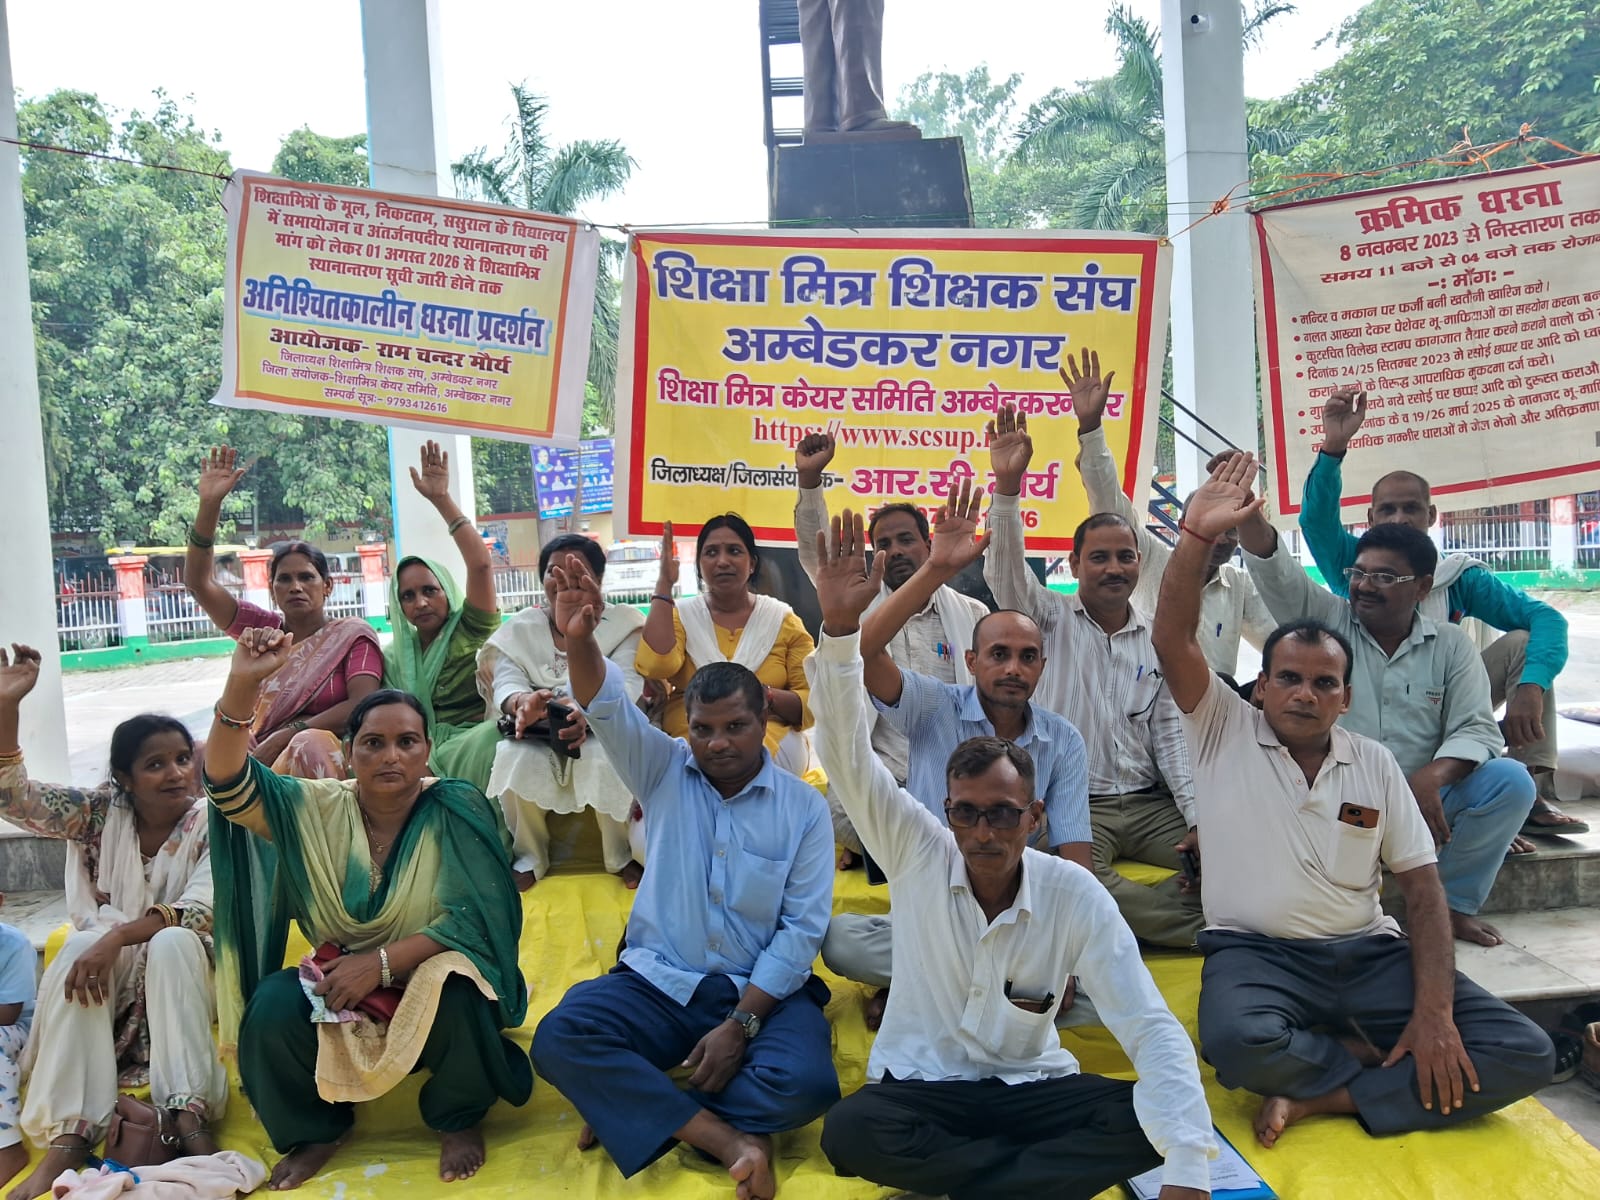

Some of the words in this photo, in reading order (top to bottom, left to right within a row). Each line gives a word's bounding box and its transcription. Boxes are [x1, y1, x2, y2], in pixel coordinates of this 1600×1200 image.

[254, 187, 322, 210] शिक्षामित्रों
[323, 195, 338, 211] के
[341, 200, 370, 219] मूल,
[375, 202, 437, 228] निकटतम,
[443, 214, 492, 234] ससुराल
[495, 219, 510, 234] के
[512, 221, 568, 242] विद्यालय
[1355, 196, 1464, 234] क्रमिक
[1478, 181, 1563, 214] धरना
[267, 208, 282, 224] में
[283, 214, 350, 234] समायोजन
[353, 222, 364, 236] व
[367, 222, 450, 247] अंतर्जनपदीय
[529, 244, 549, 261] की
[1340, 246, 1351, 261] 8
[1356, 234, 1418, 258] नवम्बर
[1423, 230, 1458, 248] 2023
[1463, 222, 1480, 244] से
[1485, 214, 1564, 240] निस्तारण
[306, 235, 327, 251] को
[328, 237, 363, 256] लेकर
[366, 244, 381, 259] 01
[384, 247, 426, 264] अगस्त
[430, 252, 460, 269] 2026
[464, 255, 477, 272] से
[479, 257, 541, 281] शिक्षामित्र
[386, 264, 414, 286] सूची
[416, 272, 448, 288] जारी
[450, 275, 476, 292] होने
[478, 280, 504, 295] तक
[654, 250, 770, 302] शिक्षा
[781, 255, 876, 307] मित्र
[889, 257, 1043, 311] शिक्षक
[1053, 262, 1136, 311] संघ
[1320, 268, 1372, 283] समय
[1379, 266, 1394, 276] 11
[1401, 256, 1434, 272] बजे
[1440, 254, 1456, 267] से
[1462, 252, 1480, 264] 04
[1486, 244, 1518, 260] बजे
[1524, 240, 1557, 254] तक
[243, 274, 416, 330] अनिश्चितकालीन
[420, 303, 474, 338] धरना
[476, 308, 545, 348] प्रदर्शन
[1300, 311, 1328, 324] मन्दिर
[1330, 312, 1338, 322] व
[1341, 306, 1378, 320] मकान
[1381, 304, 1396, 316] पर
[1398, 296, 1424, 312] फर्जी
[1426, 294, 1447, 310] बनी
[1488, 284, 1522, 300] खारिज
[1304, 330, 1328, 342] गलत
[1330, 327, 1362, 341] आख्या
[1366, 322, 1391, 336] देकर
[1394, 317, 1426, 333] पेशेवर
[1498, 306, 1513, 317] का
[1516, 298, 1549, 314] सहयोग
[1552, 294, 1580, 308] करना
[270, 327, 370, 353] आयोजक-
[376, 342, 412, 360] राम
[416, 348, 466, 368] चन्दर
[470, 352, 512, 374] मौर्य
[722, 316, 942, 368] अम्बेडकर
[950, 334, 1066, 370] नगर
[1307, 366, 1338, 380] दिनांक
[1342, 363, 1374, 376] 24/25
[1377, 356, 1418, 372] सितम्बर
[1422, 352, 1450, 366] 2023
[1520, 340, 1534, 351] घर
[1536, 332, 1561, 348] आदि
[1563, 328, 1580, 343] को
[1346, 342, 1378, 358] विलेख
[1381, 339, 1412, 353] स्टाम्प
[1416, 332, 1462, 347] कागजात
[1465, 326, 1490, 341] तैयार
[1494, 320, 1518, 336] करने
[1521, 316, 1546, 331] कराने
[1550, 312, 1574, 328] वालों
[1577, 308, 1594, 320] को
[262, 360, 289, 376] जिला
[380, 377, 404, 391] केयर
[406, 382, 440, 398] समिति,
[490, 394, 512, 406] नगर
[280, 348, 326, 367] जिलाध्यक्ष
[328, 354, 372, 373] शिक्षामित्र
[375, 360, 405, 376] शिक्षक
[430, 370, 473, 386] अम्बेडकर
[476, 378, 498, 389] नगर
[658, 367, 718, 402] शिक्षा
[724, 374, 774, 408] मित्र
[781, 378, 847, 411] केयर
[850, 379, 936, 413] समिति
[1366, 378, 1376, 392] के
[1412, 368, 1464, 386] आपराधिक
[1468, 362, 1504, 380] मुकदमा
[1508, 356, 1524, 370] दर्ज
[1388, 394, 1404, 406] गये
[1408, 388, 1432, 403] रसोई
[1436, 388, 1450, 400] घर
[1482, 378, 1504, 394] आदि
[1508, 375, 1522, 389] को
[324, 387, 355, 400] सम्पर्क
[386, 396, 448, 412] 9793412616
[1388, 412, 1400, 425] के
[1402, 413, 1409, 423] व
[1412, 409, 1446, 422] 19/26
[1448, 401, 1469, 416] मार्च
[1472, 400, 1500, 414] 2025
[1504, 394, 1516, 408] के
[1518, 390, 1560, 406] नामजद
[1388, 430, 1420, 444] गम्भीर
[1422, 422, 1455, 438] धाराओं
[1493, 412, 1516, 428] भेजो
[1520, 410, 1540, 424] और
[1544, 400, 1600, 420] अतिक्रमण
